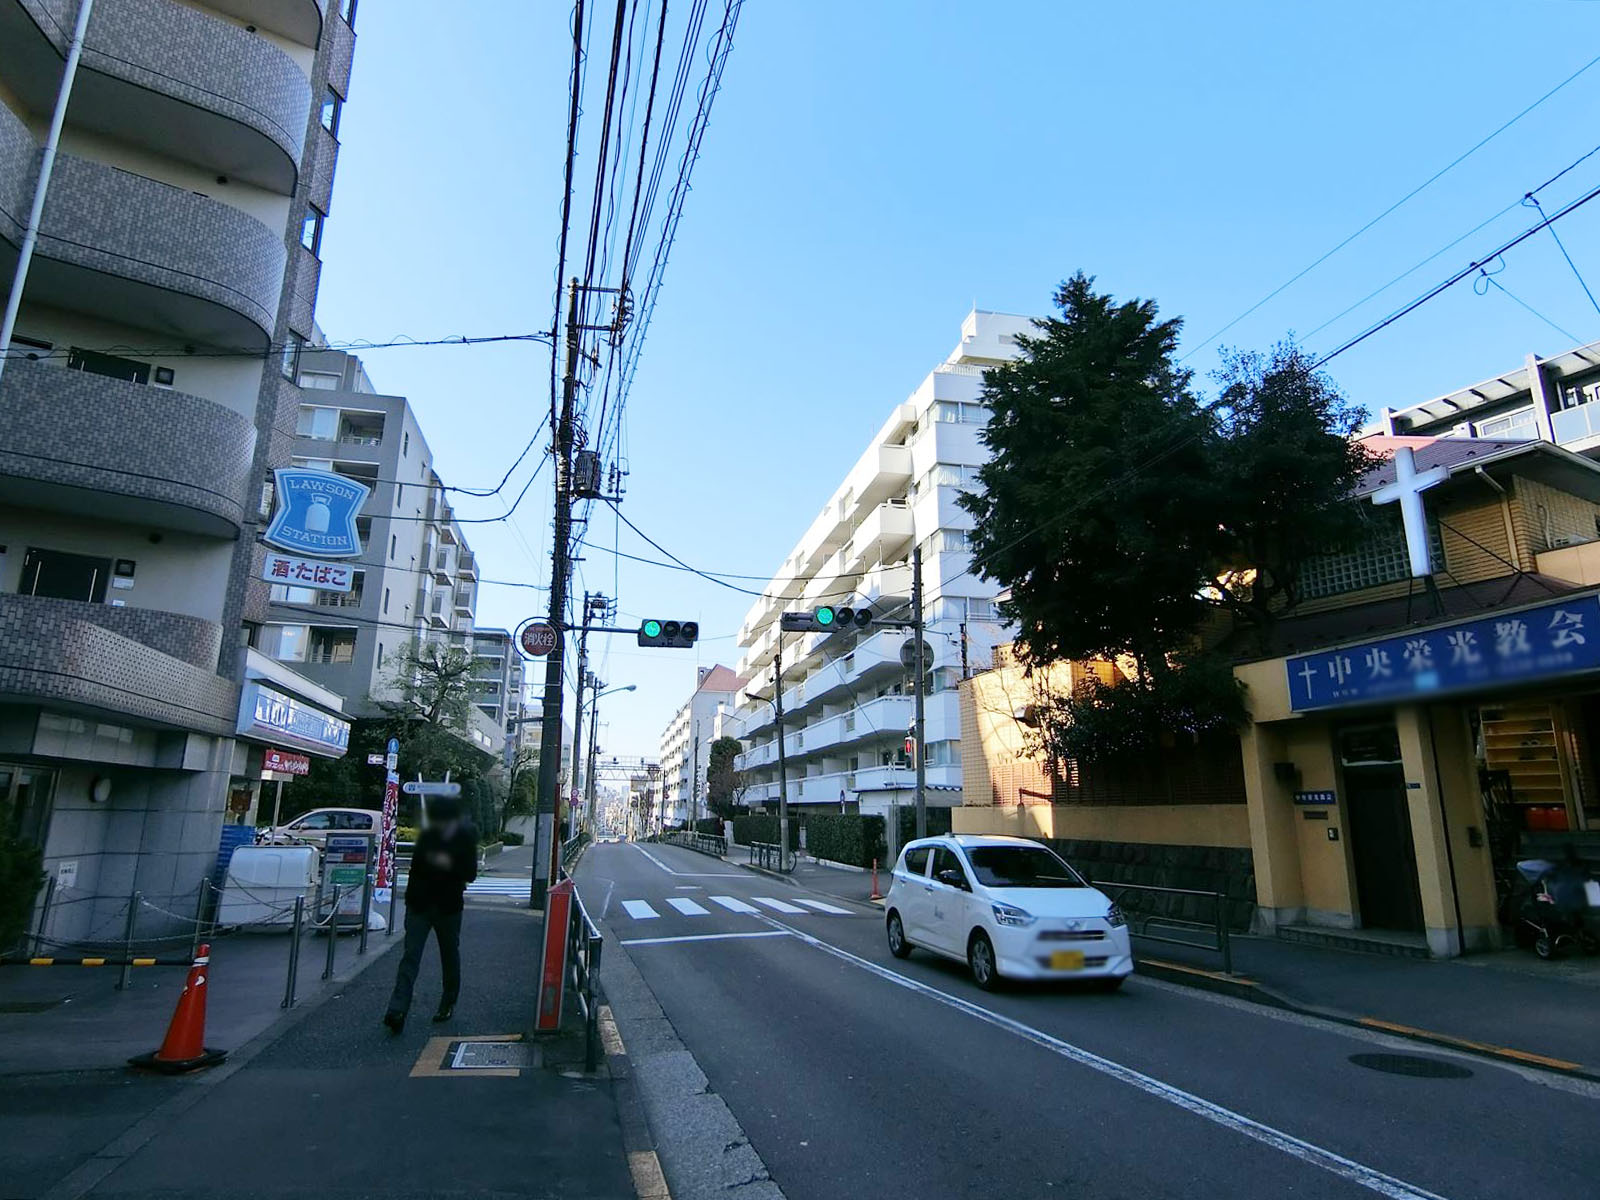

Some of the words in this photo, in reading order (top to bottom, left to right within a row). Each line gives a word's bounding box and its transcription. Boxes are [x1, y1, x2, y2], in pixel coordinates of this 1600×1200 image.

[289, 479, 355, 500] LAWSON
[281, 525, 348, 545] STATION
[271, 559, 347, 586] 酒・たばこ
[524, 632, 554, 646] 消火栓
[1328, 609, 1586, 685] 中央栄光教会
